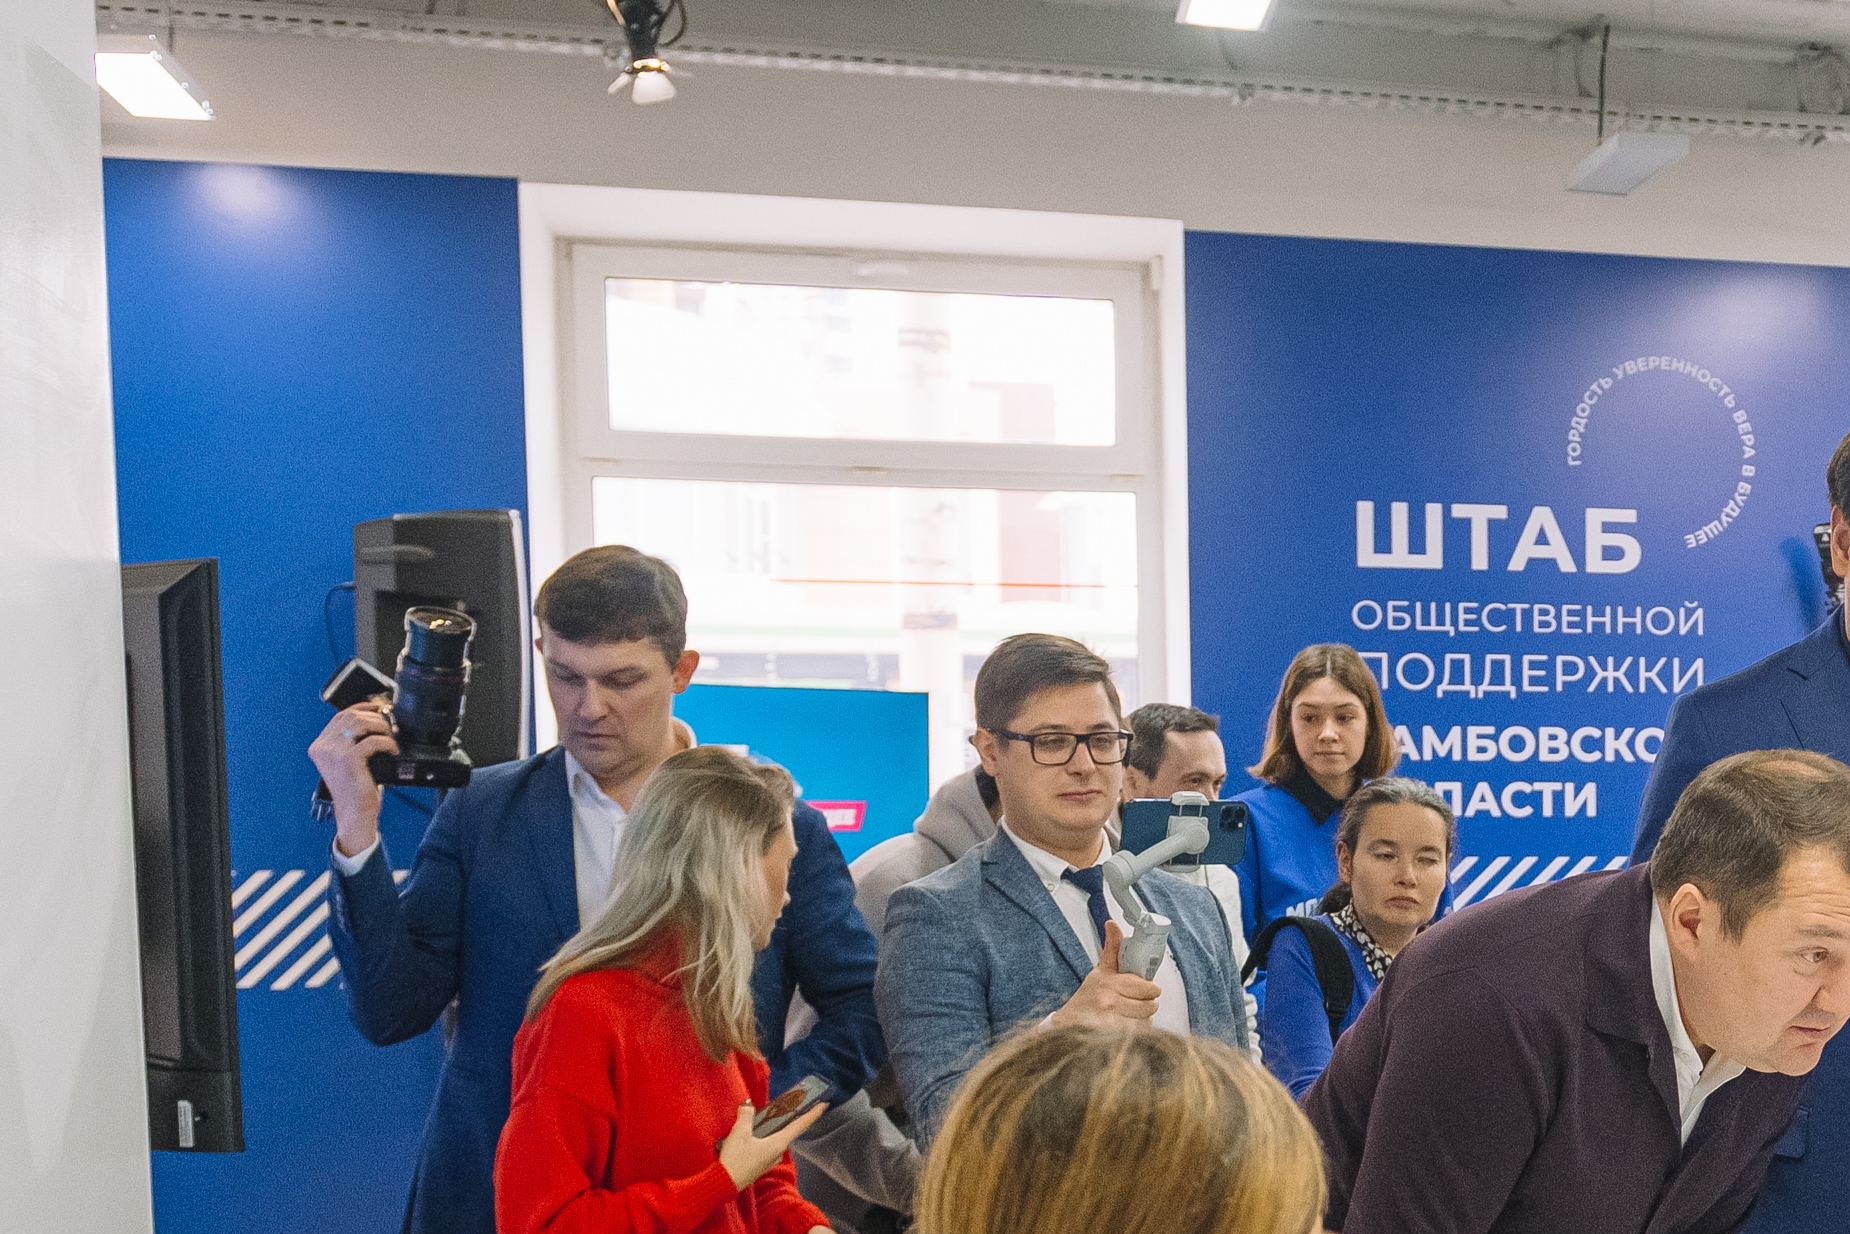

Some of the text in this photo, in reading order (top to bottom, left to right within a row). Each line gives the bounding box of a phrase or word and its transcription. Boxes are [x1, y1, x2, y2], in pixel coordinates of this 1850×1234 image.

[1567, 356, 1756, 549] ГОРДОСТЬ УВЕРЕННОСТЬ ВЕРА В БУДУЩЕЕ
[1356, 500, 1642, 574] ШТАБ
[1351, 600, 1704, 637] ОБЩЕСТВЕННОЙ
[1358, 651, 1704, 699] ПОДДЕРЖКИ
[1394, 725, 1664, 763] АМБОВСКО
[1422, 780, 1598, 818] ЛАСТИ
